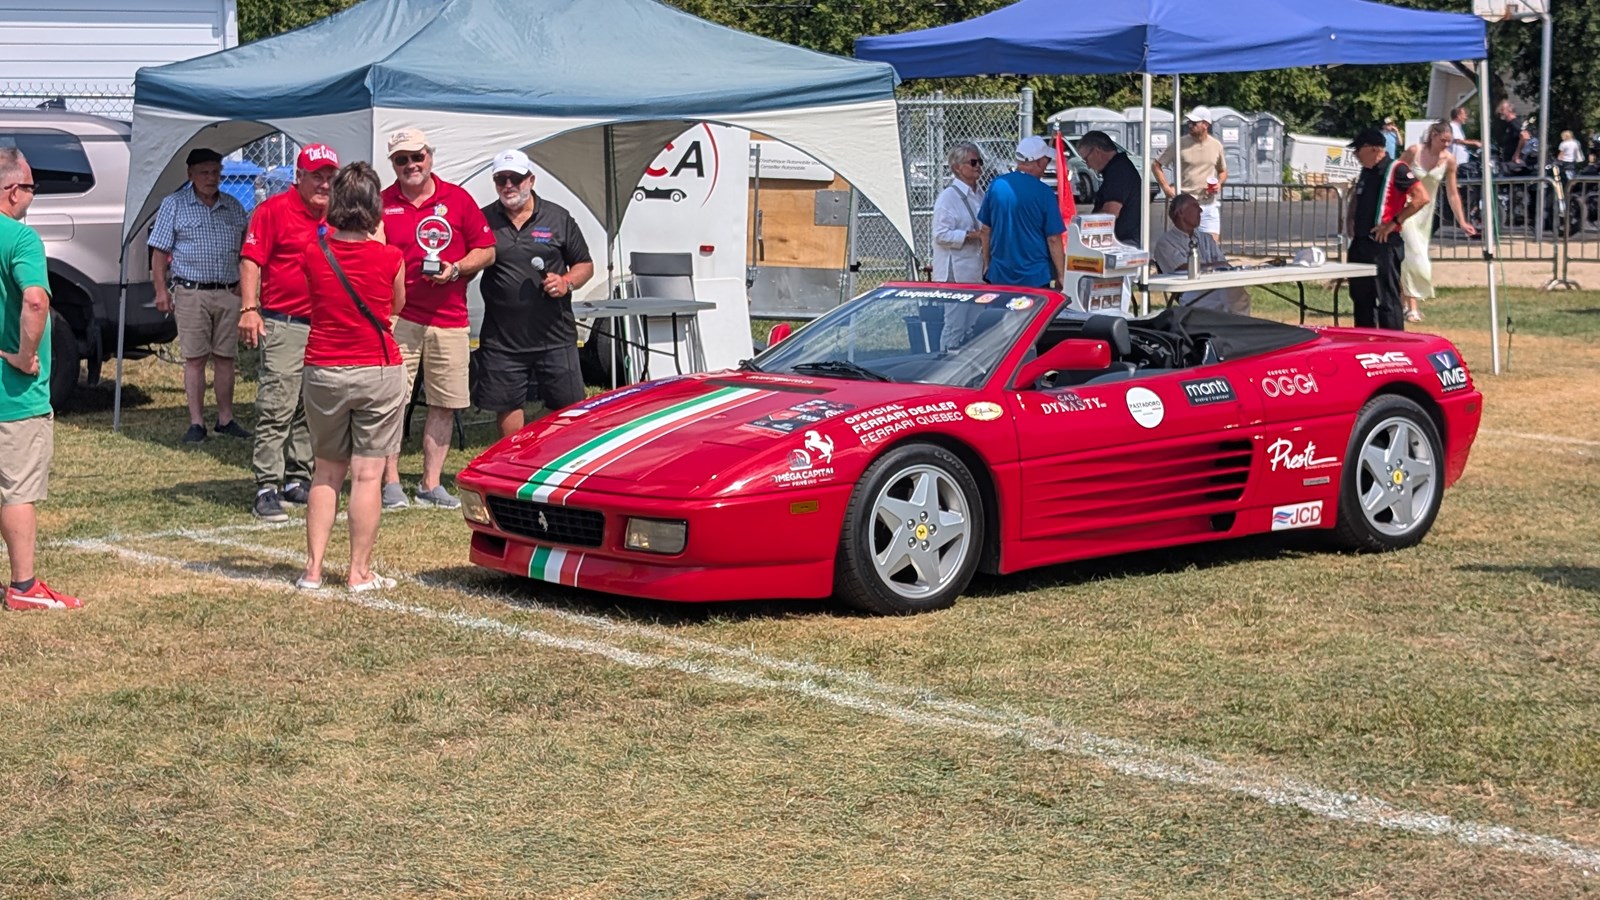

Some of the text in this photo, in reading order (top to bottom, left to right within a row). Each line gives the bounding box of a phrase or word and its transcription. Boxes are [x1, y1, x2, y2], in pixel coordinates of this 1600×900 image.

[1261, 373, 1319, 398] OGGI
[1436, 367, 1467, 387] VMG
[1057, 394, 1079, 402] CASA
[1186, 380, 1229, 397] manti
[844, 403, 904, 424] OFFICIAL
[1041, 397, 1101, 414] DYNASTY
[852, 411, 909, 434] FERRARI
[907, 401, 958, 416] DEALER
[859, 419, 916, 446] FERRARI
[915, 411, 964, 425] QUEBEC
[1267, 437, 1337, 472] Presti
[1290, 506, 1321, 525] JCD
